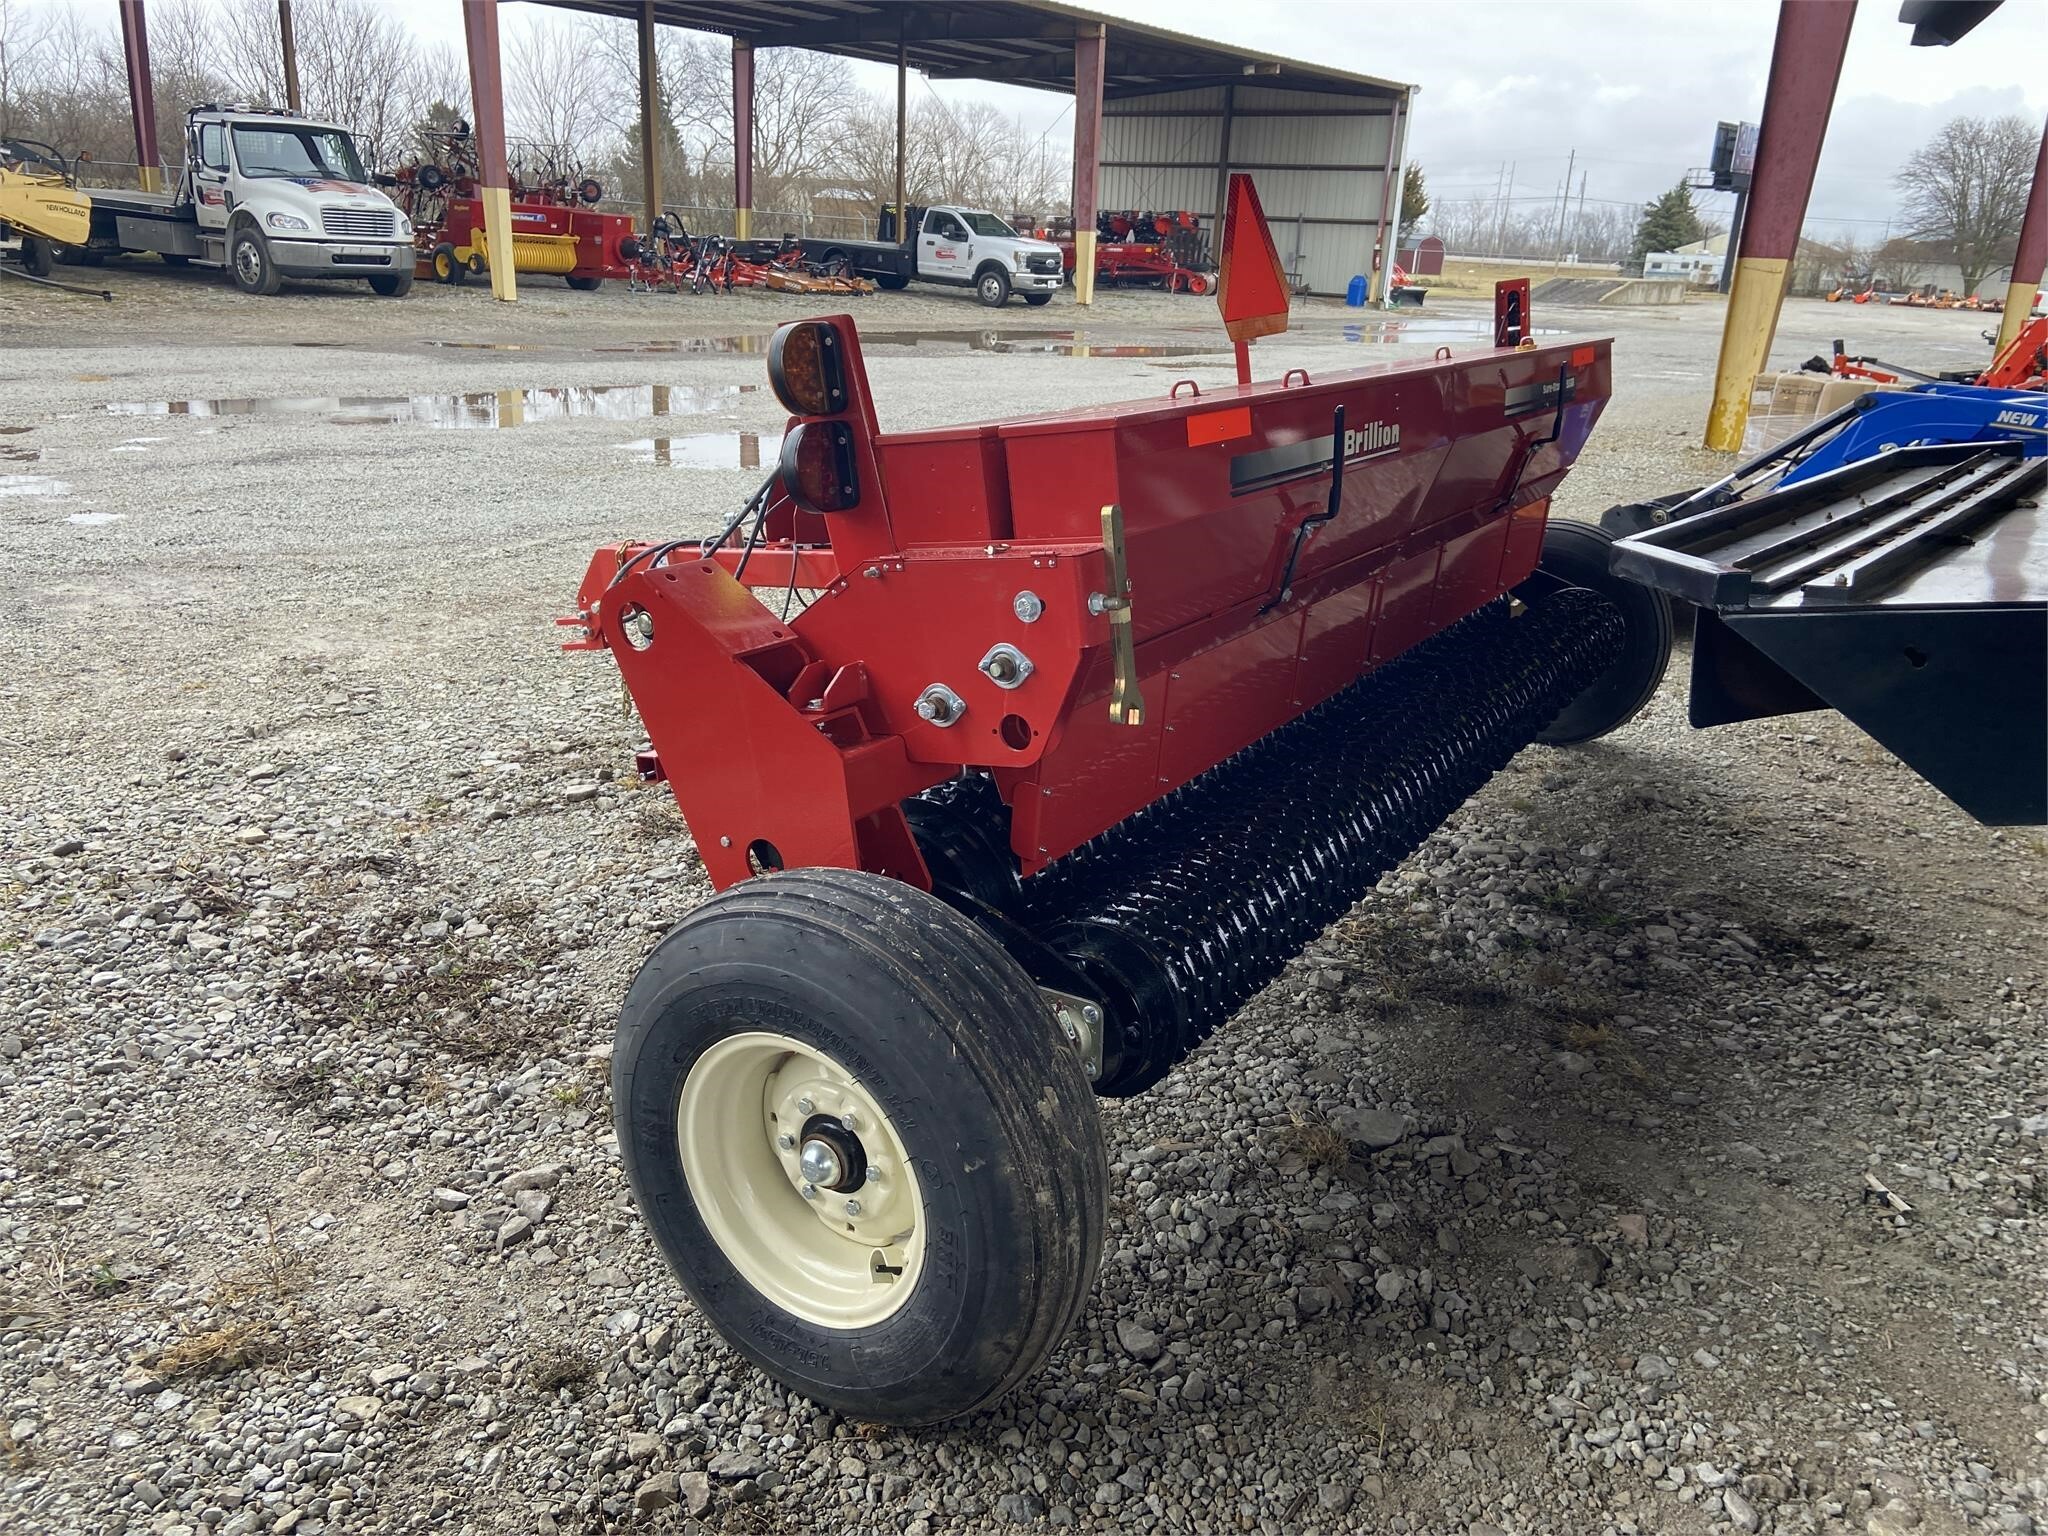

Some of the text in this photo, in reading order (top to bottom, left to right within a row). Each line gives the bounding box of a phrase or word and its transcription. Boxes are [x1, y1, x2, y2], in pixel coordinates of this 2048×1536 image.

[60, 207, 86, 217] HOLLAND
[1996, 410, 2040, 426] NEW
[1344, 420, 1400, 456] Brillion
